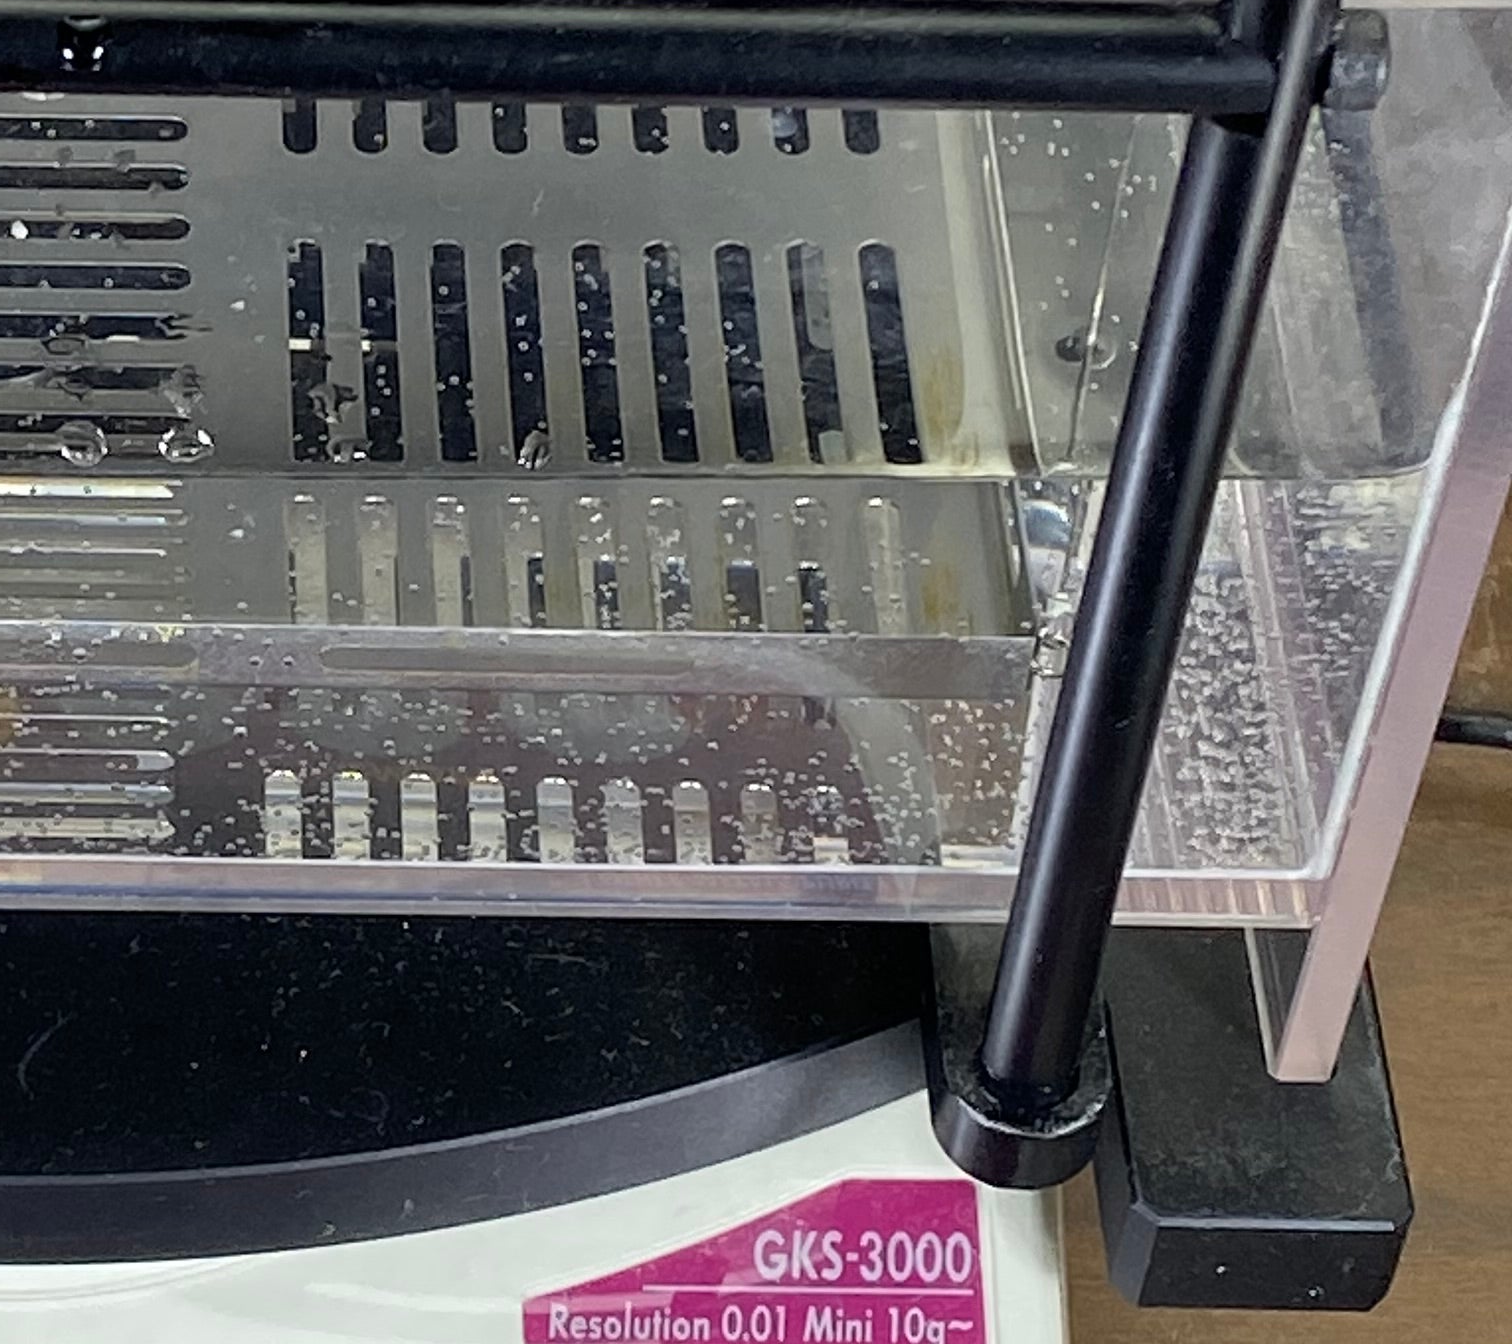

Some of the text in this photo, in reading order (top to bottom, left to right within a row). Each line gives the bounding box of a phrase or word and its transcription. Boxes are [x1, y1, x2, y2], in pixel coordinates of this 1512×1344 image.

[752, 1229, 973, 1284] GKS-3000
[548, 1302, 710, 1343] Resolution
[721, 1306, 787, 1344] 0.01
[802, 1307, 873, 1344] Mini
